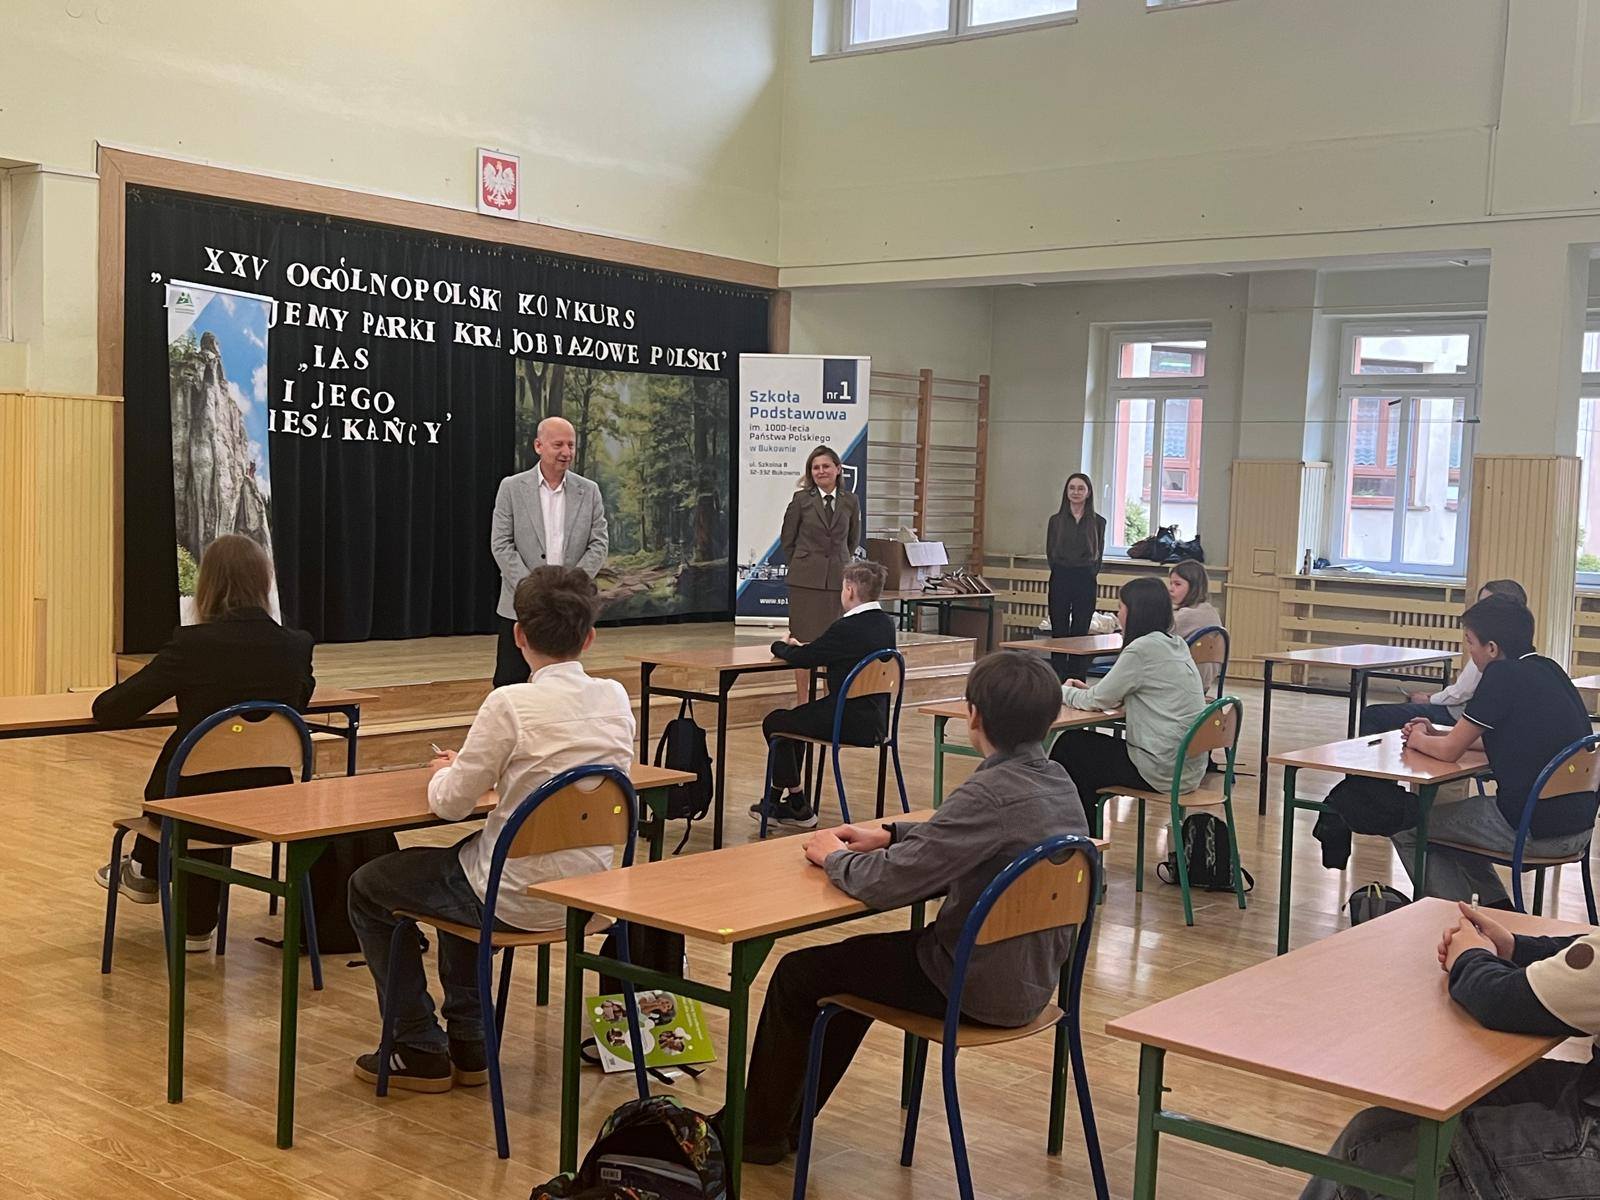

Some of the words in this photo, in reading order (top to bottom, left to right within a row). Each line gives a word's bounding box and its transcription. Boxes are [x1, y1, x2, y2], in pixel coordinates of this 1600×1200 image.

[205, 247, 269, 280] XXV
[517, 292, 636, 331] KONKURS
[361, 311, 436, 343] PARKI
[282, 378, 296, 403] I
[310, 380, 396, 414] JEGO
[750, 390, 800, 403] Szkoła
[839, 381, 852, 400] 1
[750, 406, 847, 420] Podstawowa
[765, 424, 810, 432] 1000-lecia
[749, 433, 787, 441] Państwa
[788, 433, 831, 443] Polskiego
[758, 444, 797, 453] Bukownie
